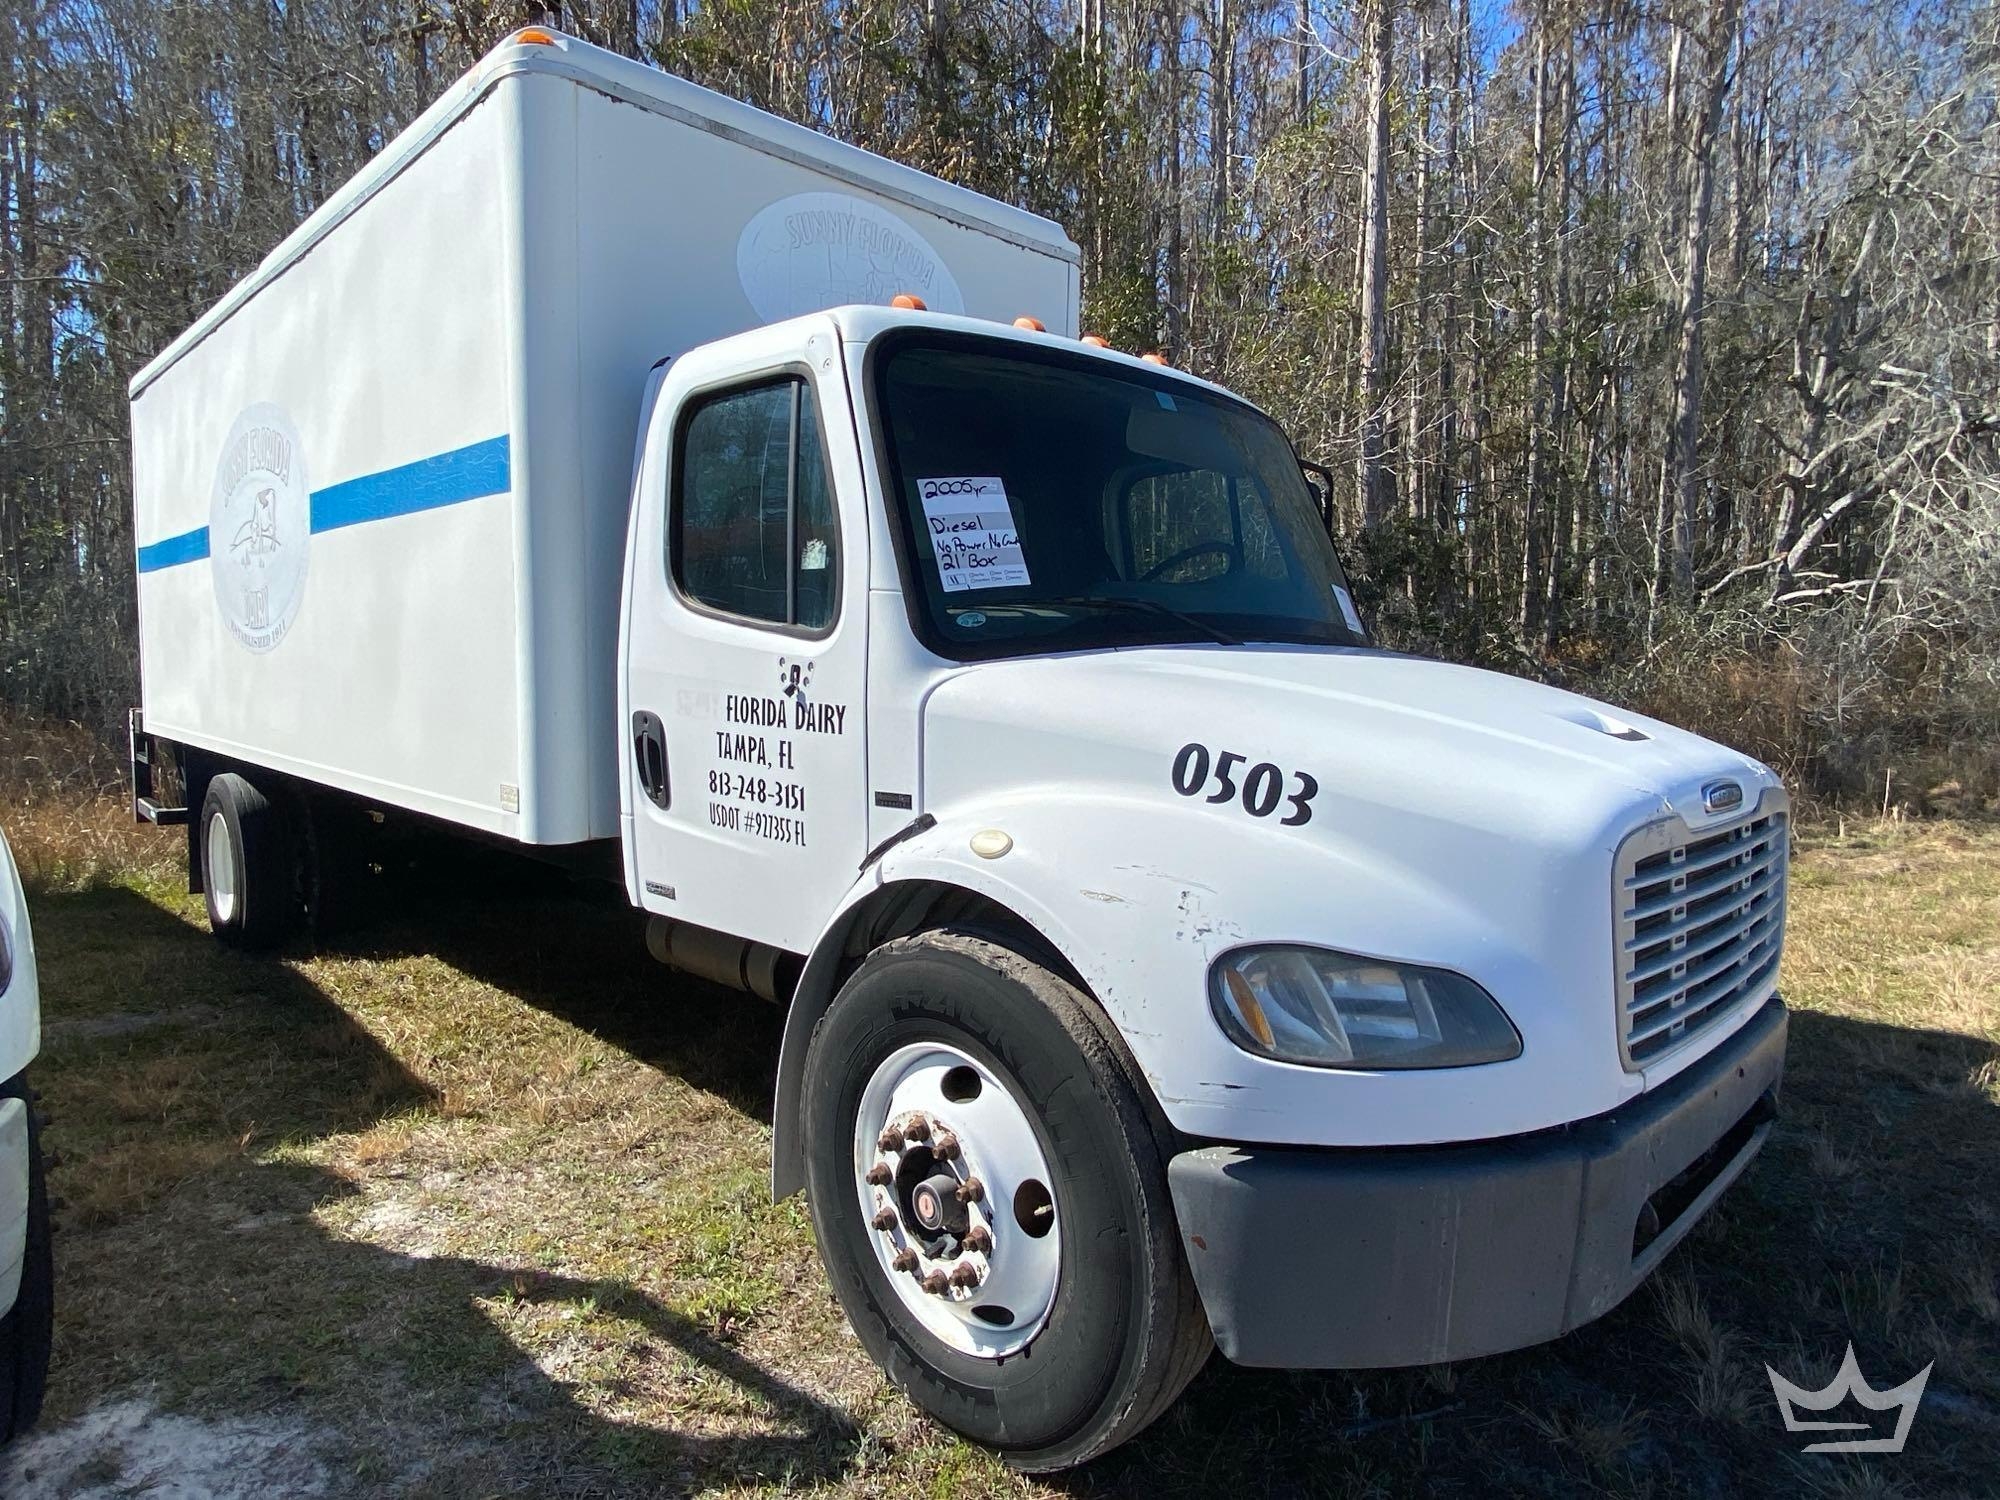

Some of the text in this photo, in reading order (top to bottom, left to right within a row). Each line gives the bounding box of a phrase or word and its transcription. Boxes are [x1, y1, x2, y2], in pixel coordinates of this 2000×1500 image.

[785, 210, 935, 290] SUNNY FLORIDA
[924, 479, 972, 499] 2005
[930, 515, 984, 534] Diesel
[936, 539, 952, 553] No
[988, 532, 1001, 550] No
[968, 553, 998, 568] Box
[726, 695, 787, 728] FLORIDA
[795, 701, 847, 735] DAIRY
[716, 731, 794, 770] TAMPA, FL
[708, 769, 805, 811] 813-248-3151
[1172, 742, 1319, 827] 0503
[709, 801, 807, 846] USDOT #927355 FL
